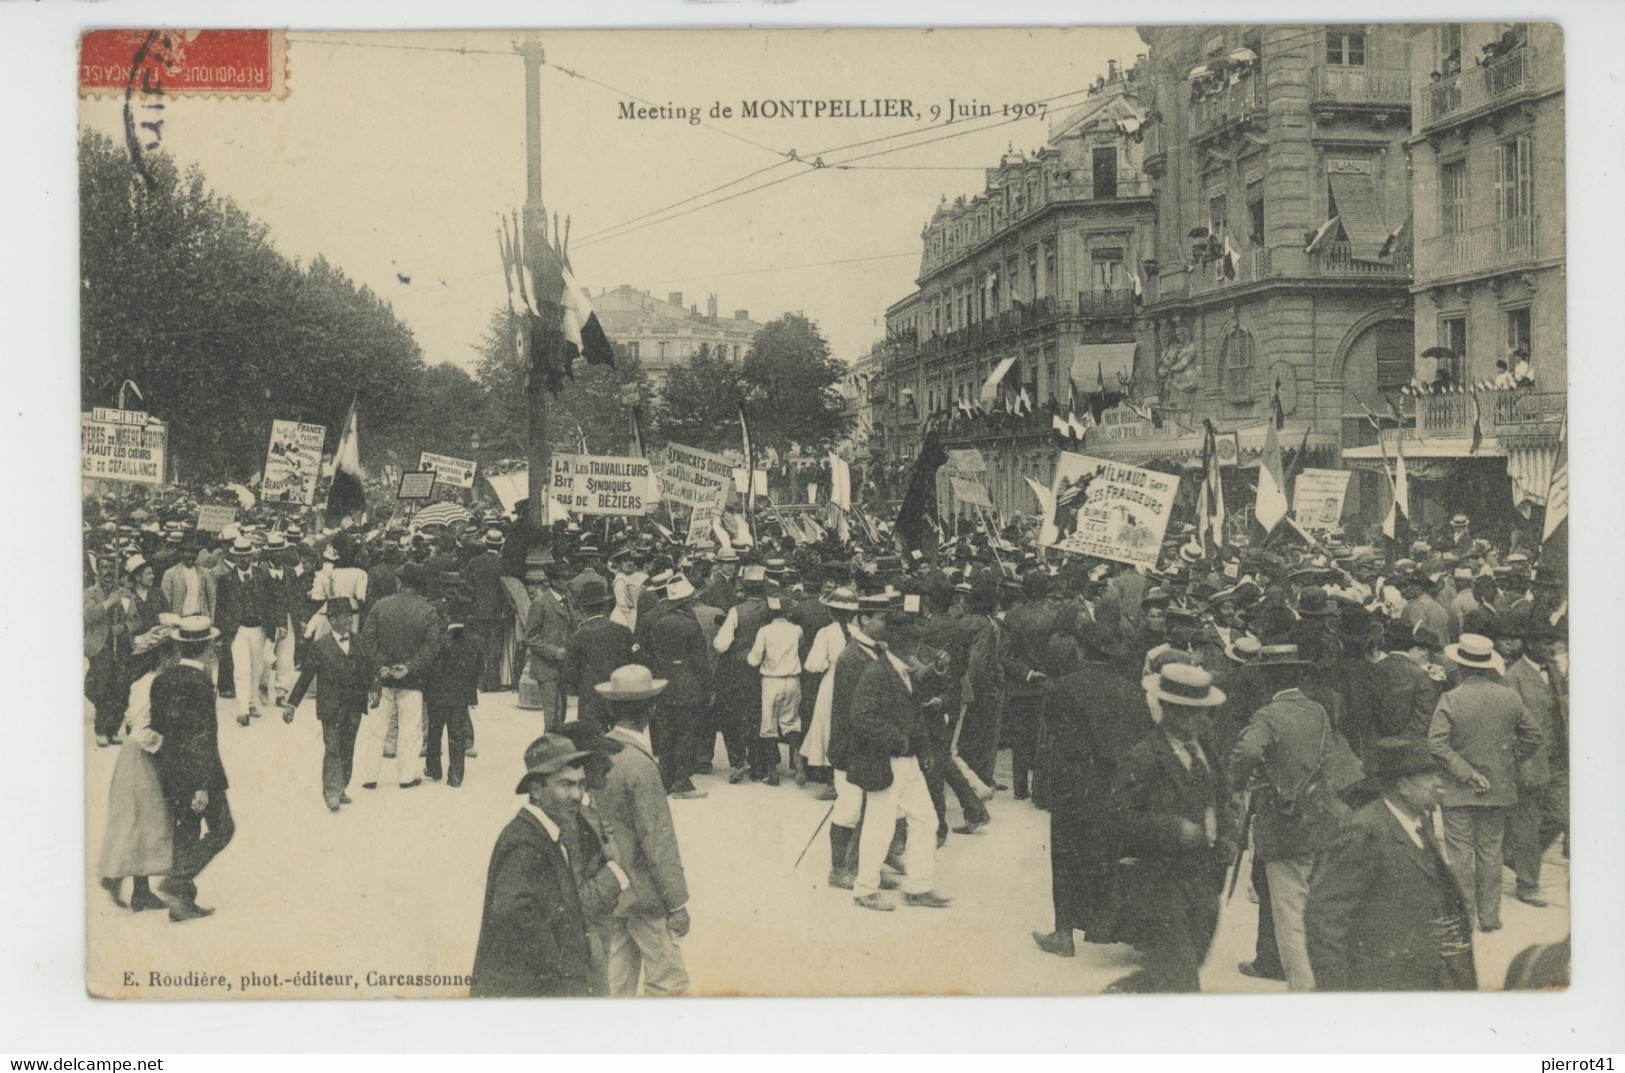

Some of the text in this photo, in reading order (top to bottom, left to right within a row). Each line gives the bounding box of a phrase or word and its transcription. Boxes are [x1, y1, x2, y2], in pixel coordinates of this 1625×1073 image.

[87, 444, 112, 457] HAUT
[113, 446, 126, 458] LES
[667, 446, 706, 470] SYNDICATS
[555, 460, 569, 473] LA
[575, 464, 589, 474] LES
[590, 461, 648, 477] TRAVAILLEURS
[554, 475, 573, 487] BIT
[576, 496, 588, 506] DE
[1106, 485, 1163, 515] FRAUDEURS
